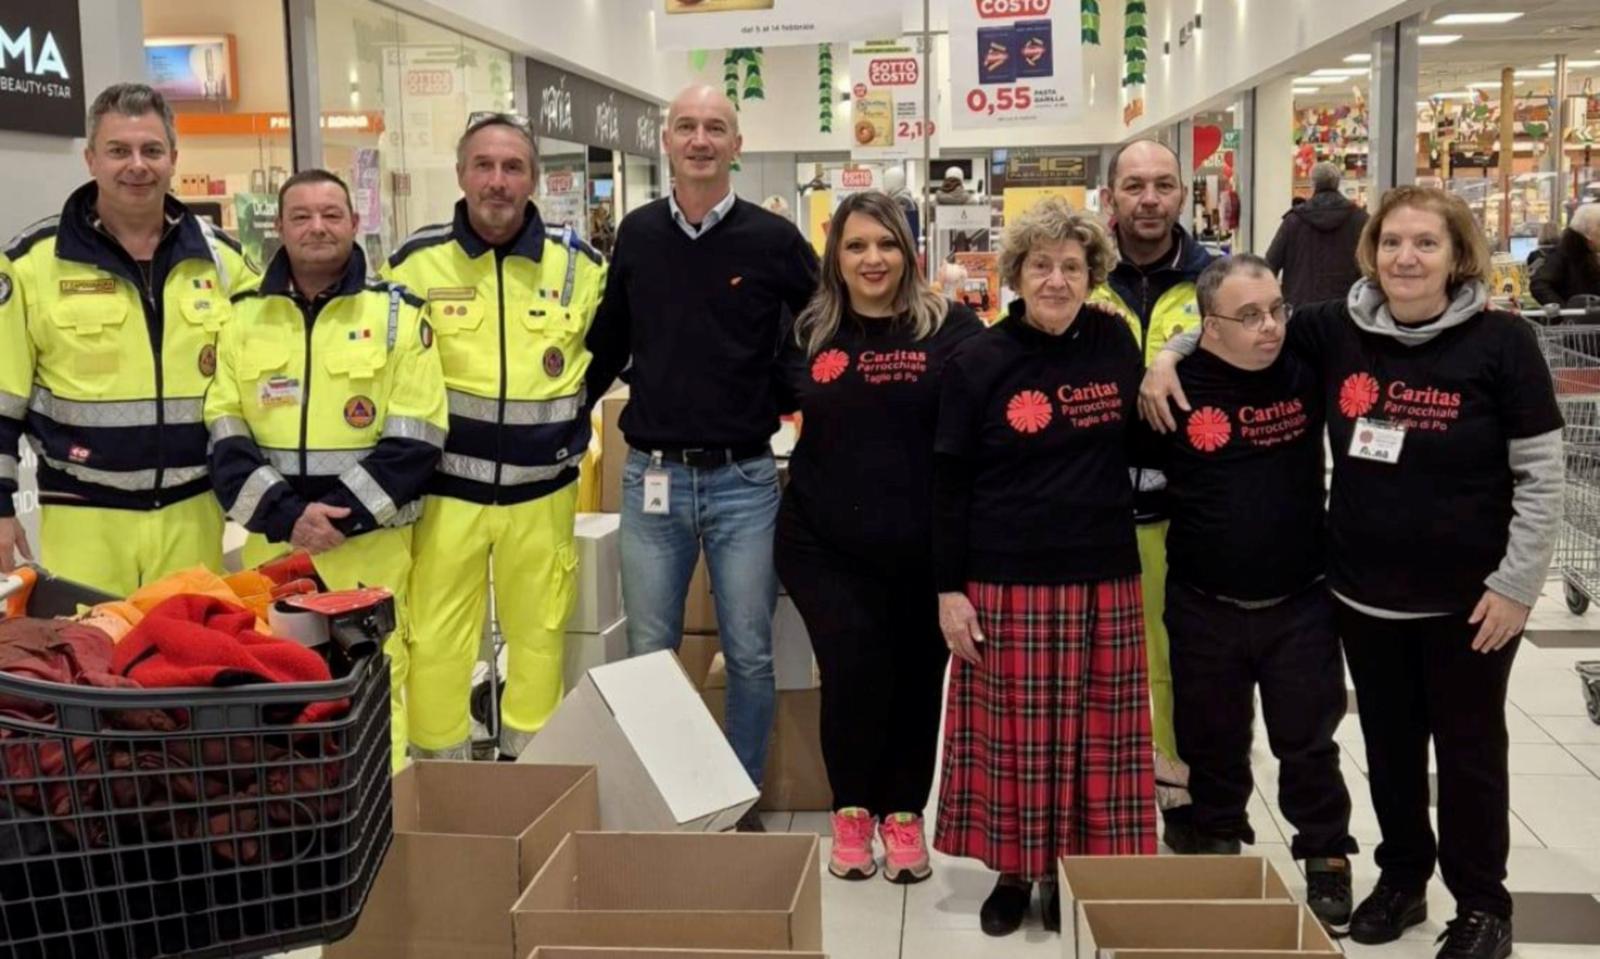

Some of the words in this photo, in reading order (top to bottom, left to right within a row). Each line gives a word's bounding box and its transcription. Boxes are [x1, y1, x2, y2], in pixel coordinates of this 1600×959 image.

[981, 0, 1048, 14] COSTO
[871, 61, 915, 72] SOTTO
[871, 71, 916, 82] COSTO
[967, 87, 1031, 115] 0,55
[898, 121, 936, 140] 2,19
[859, 349, 926, 363] Caritas
[857, 361, 926, 372] Parrocchiale
[905, 372, 918, 382] Po
[1057, 381, 1119, 403] Caritas
[1387, 380, 1461, 407] Caritas
[1061, 398, 1122, 416] Parrocchiale
[1239, 398, 1302, 424] Caritas
[1384, 400, 1459, 419] Parrocchiale
[1241, 414, 1307, 437] Parrocchiale
[1433, 421, 1448, 431] Po
